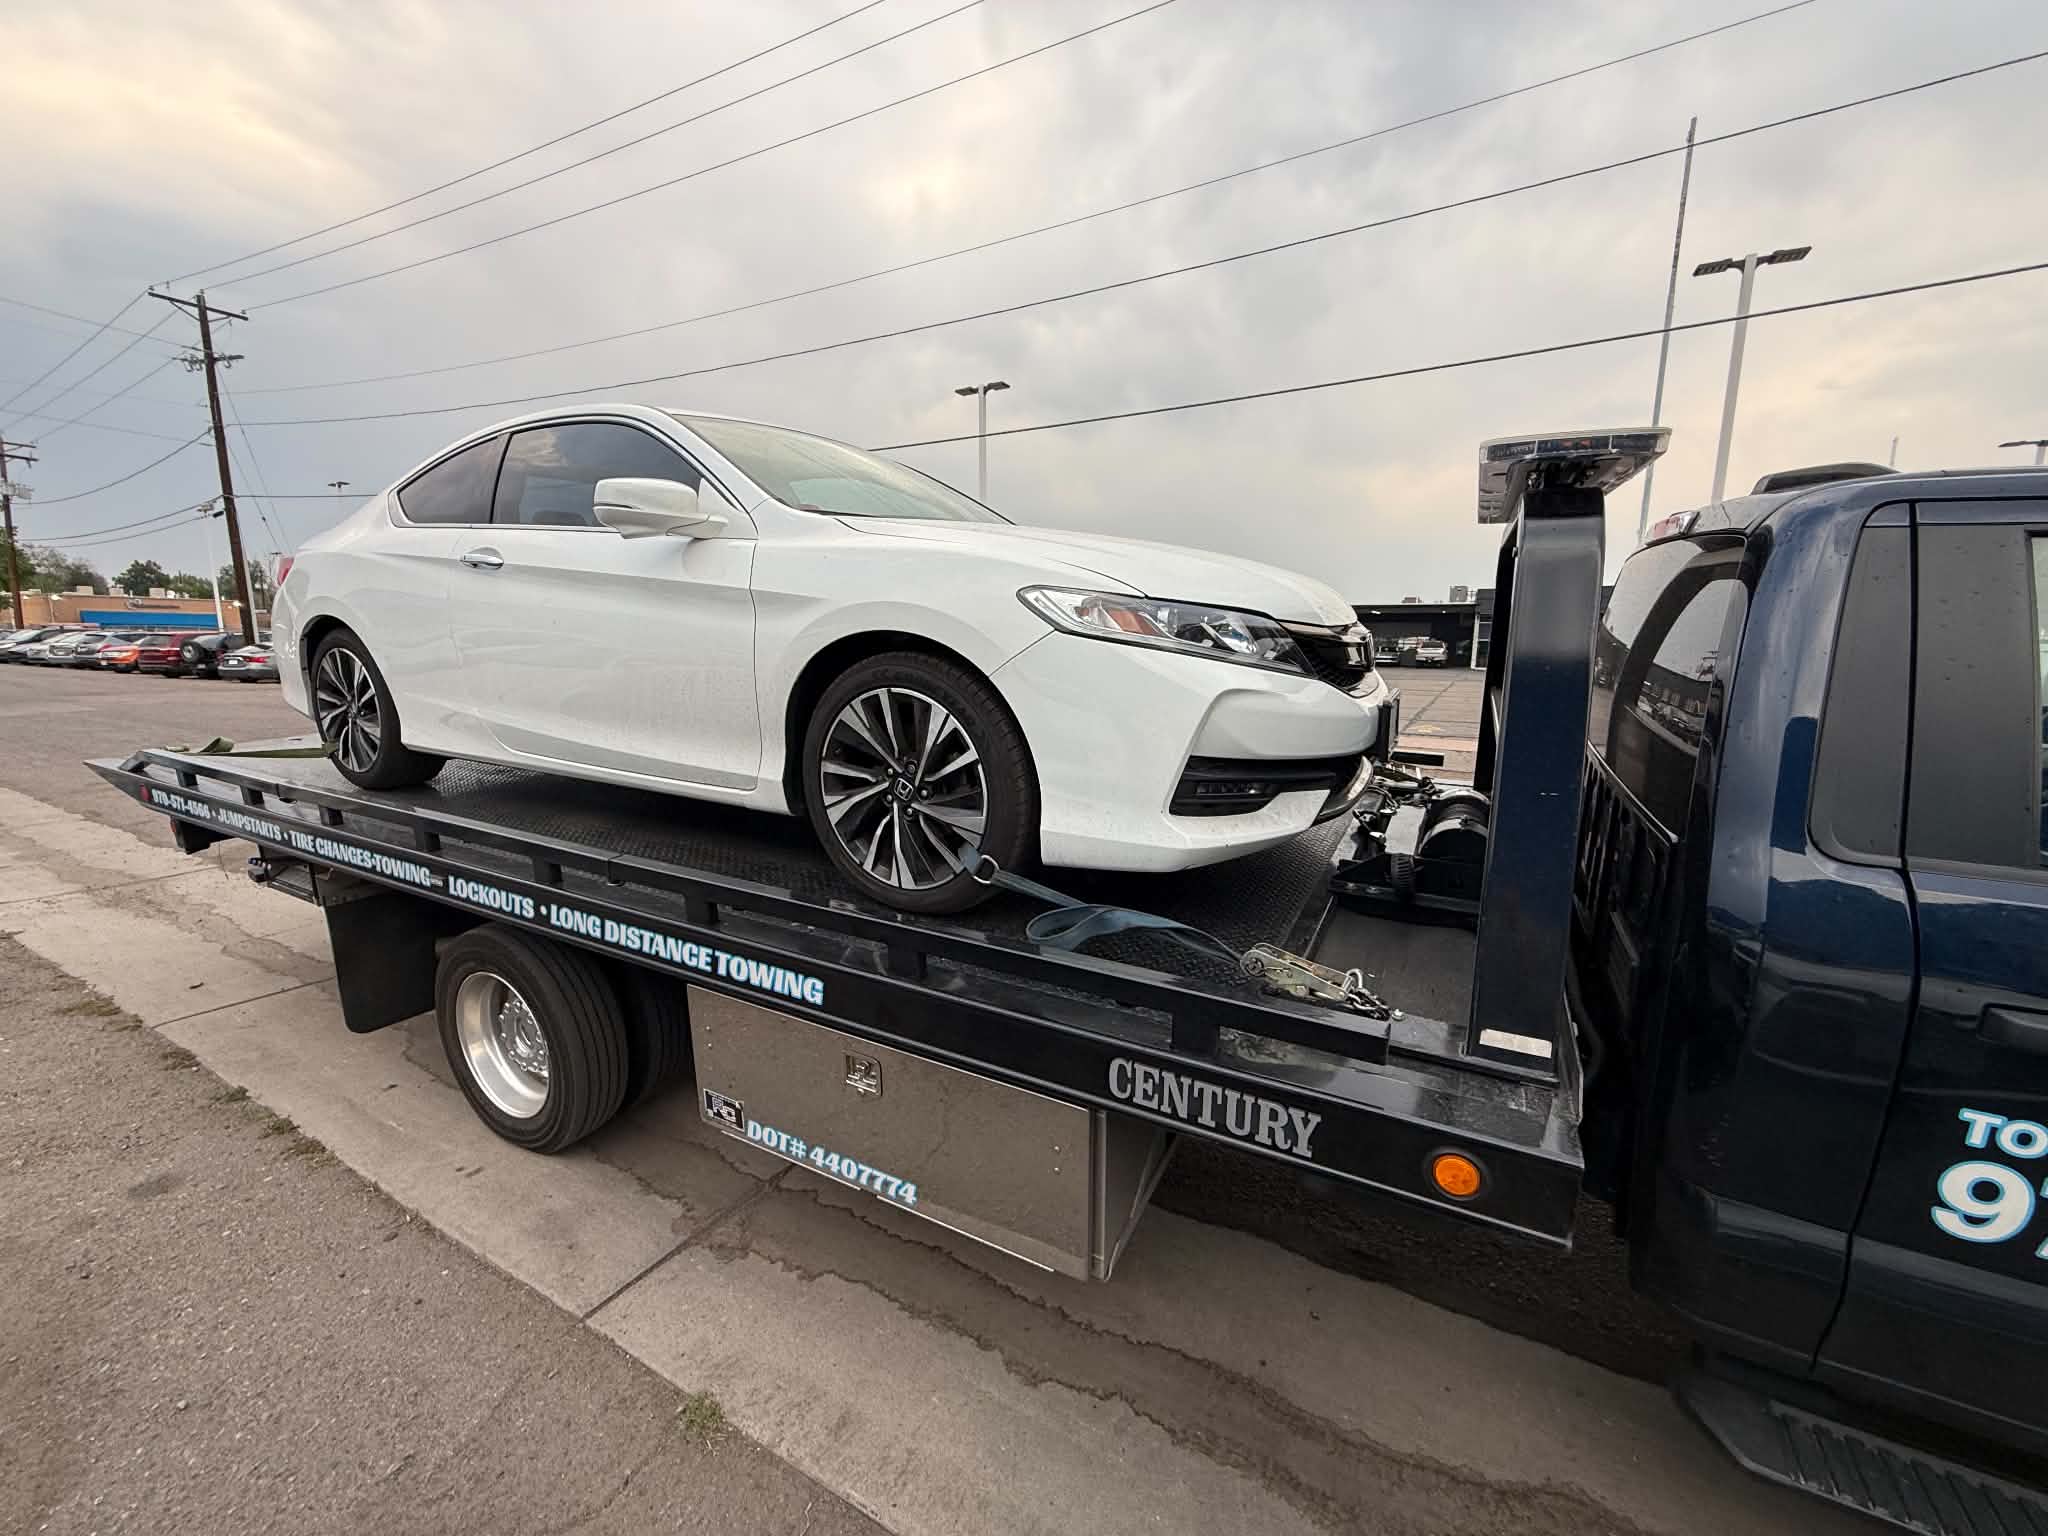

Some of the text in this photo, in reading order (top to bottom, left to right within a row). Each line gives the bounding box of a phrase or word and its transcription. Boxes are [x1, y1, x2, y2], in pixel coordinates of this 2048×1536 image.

[218, 808, 282, 841] JUMPSTARTS
[289, 829, 315, 853] TIRE
[448, 875, 535, 920] LOCKOUTS
[550, 903, 602, 939] LONG
[604, 919, 712, 973] DISTANCE
[715, 950, 825, 1005] TOWING
[1108, 1057, 1322, 1159] CENTURY
[747, 1119, 917, 1205] DOT# 4407774
